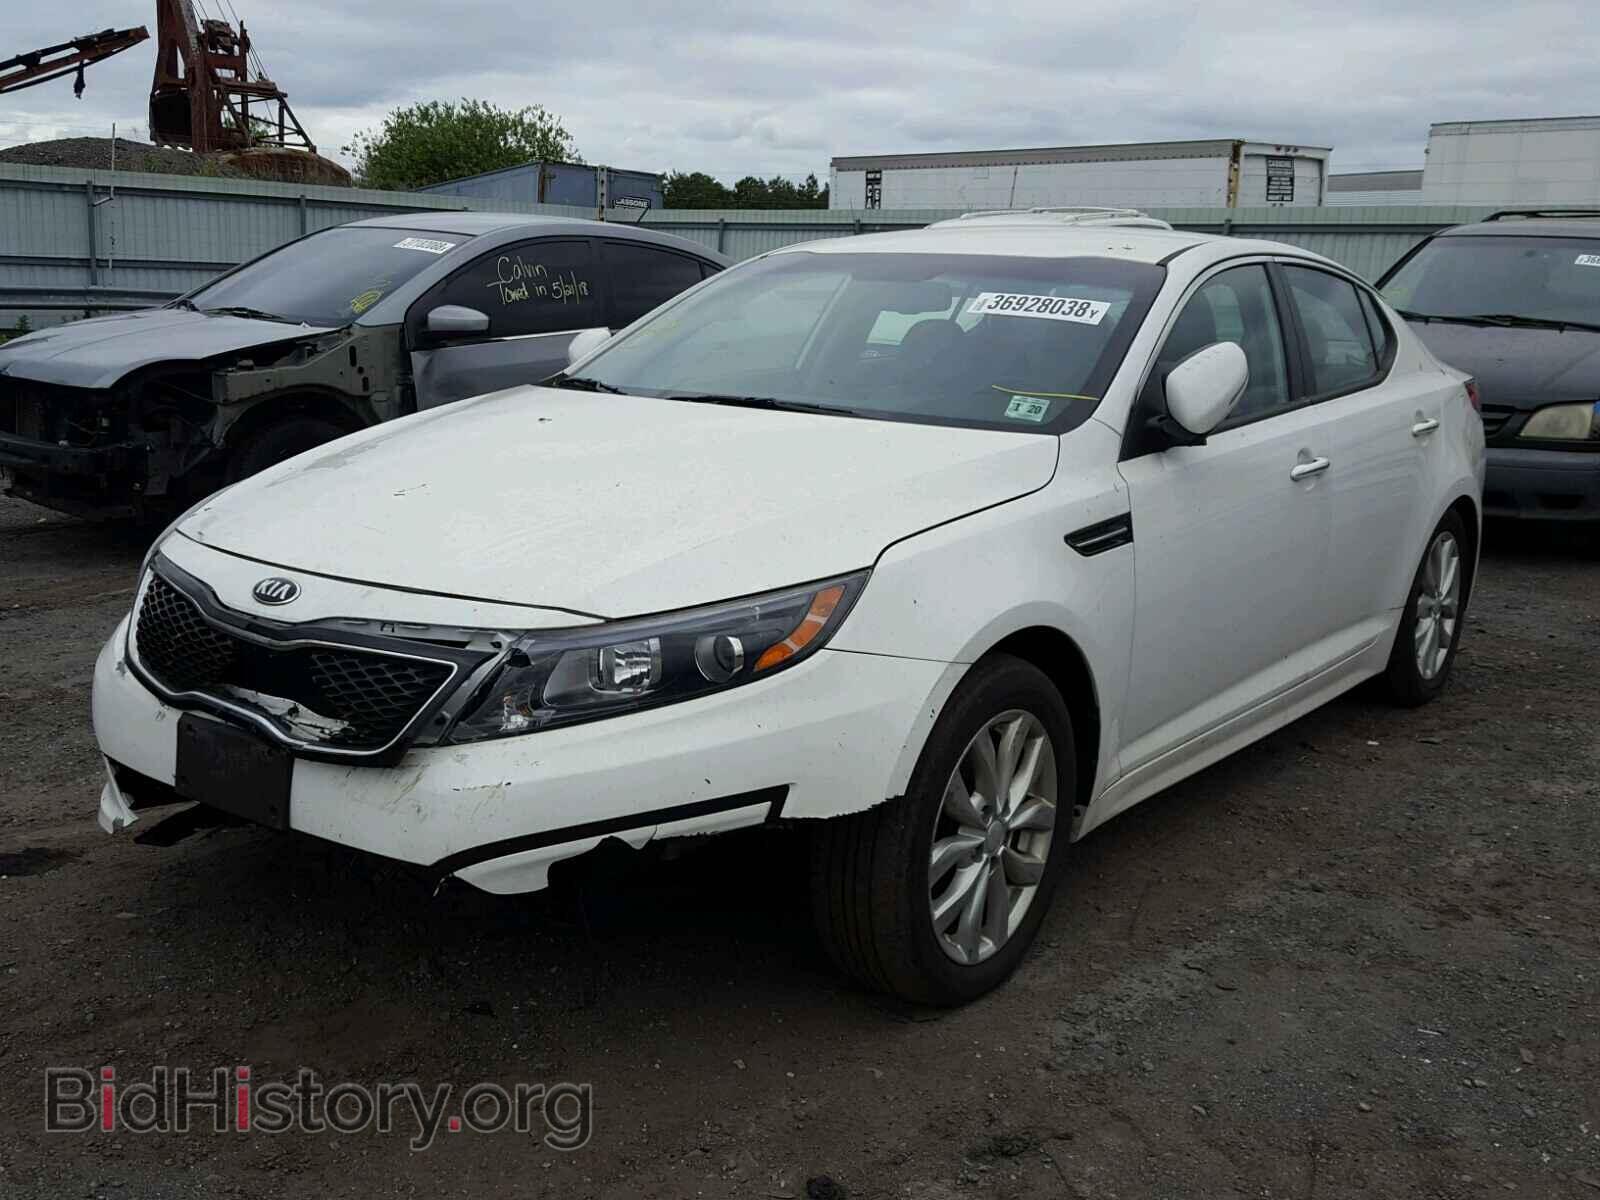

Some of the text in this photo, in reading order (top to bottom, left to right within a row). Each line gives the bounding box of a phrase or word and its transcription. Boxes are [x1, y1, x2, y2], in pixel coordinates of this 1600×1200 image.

[498, 256, 548, 283] Calvin
[533, 282, 548, 297] in
[1026, 404, 1042, 415] 20
[255, 579, 291, 600] KIA
